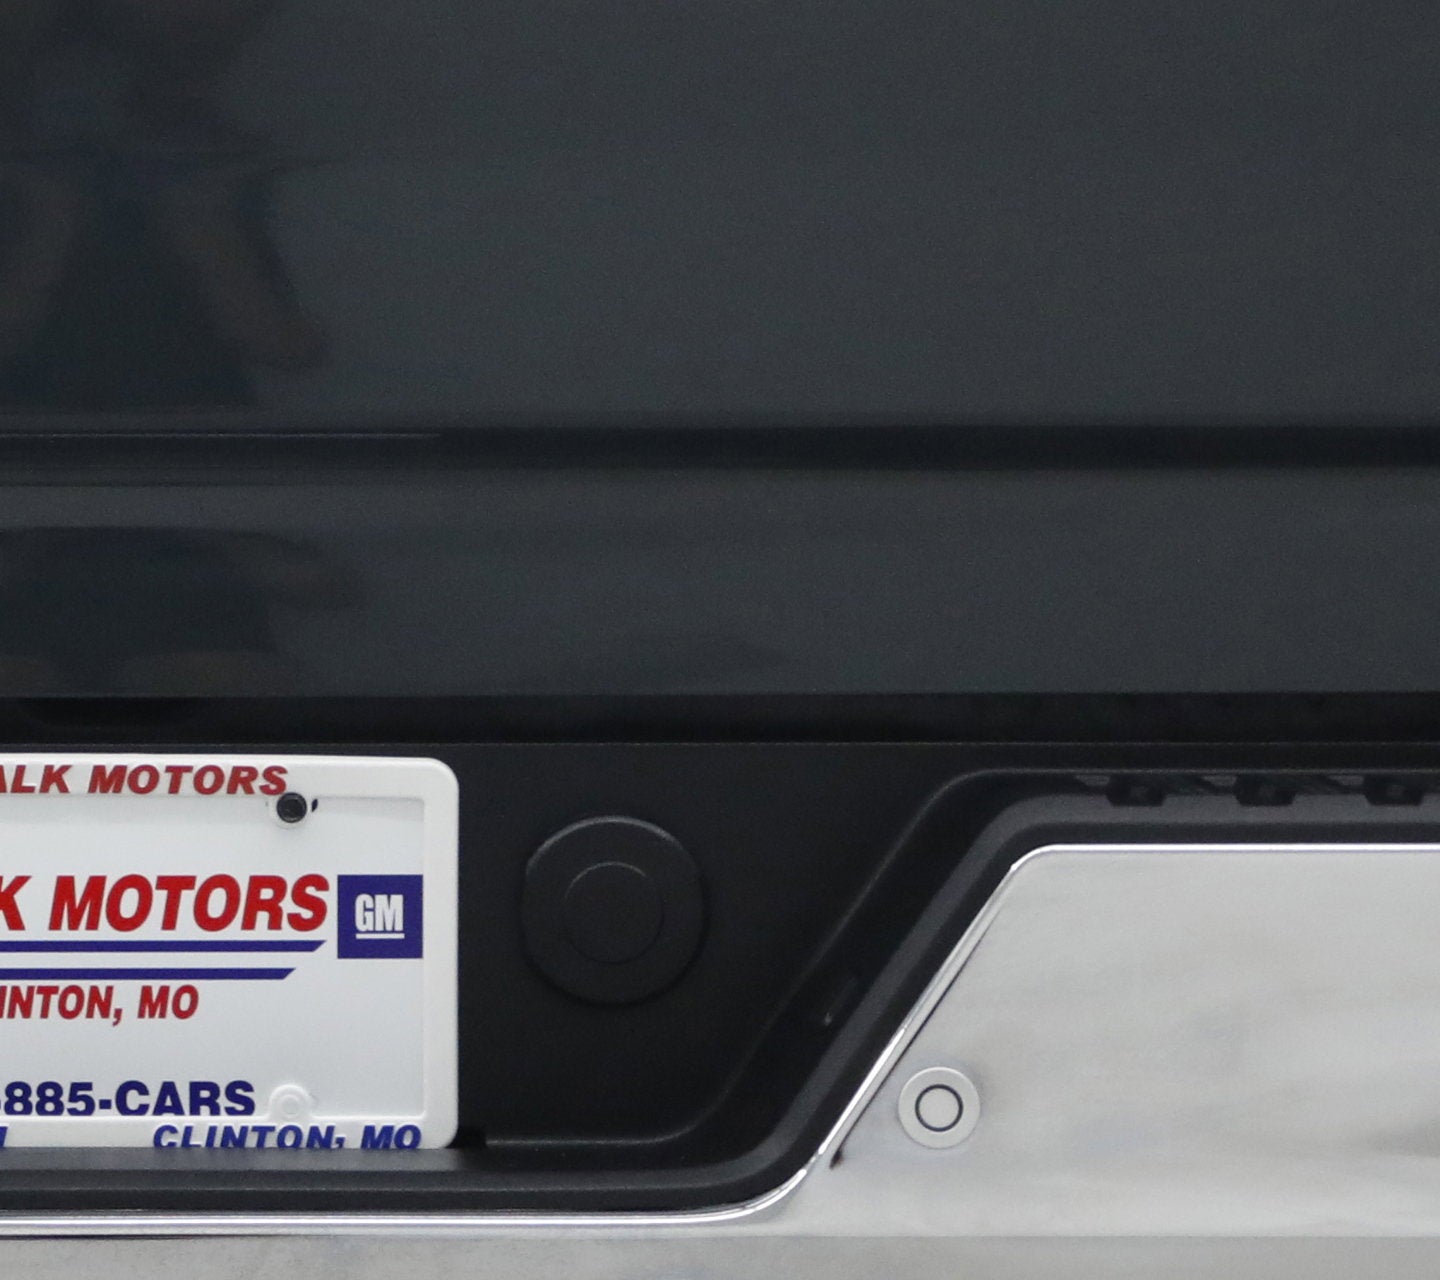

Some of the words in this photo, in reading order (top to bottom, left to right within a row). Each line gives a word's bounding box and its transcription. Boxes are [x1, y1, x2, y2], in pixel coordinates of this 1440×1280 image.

[89, 765, 287, 795] MOTORS
[49, 873, 330, 933] MOTORS
[355, 893, 404, 932] GM
[138, 984, 199, 1020] MO
[359, 1123, 423, 1152] MO
